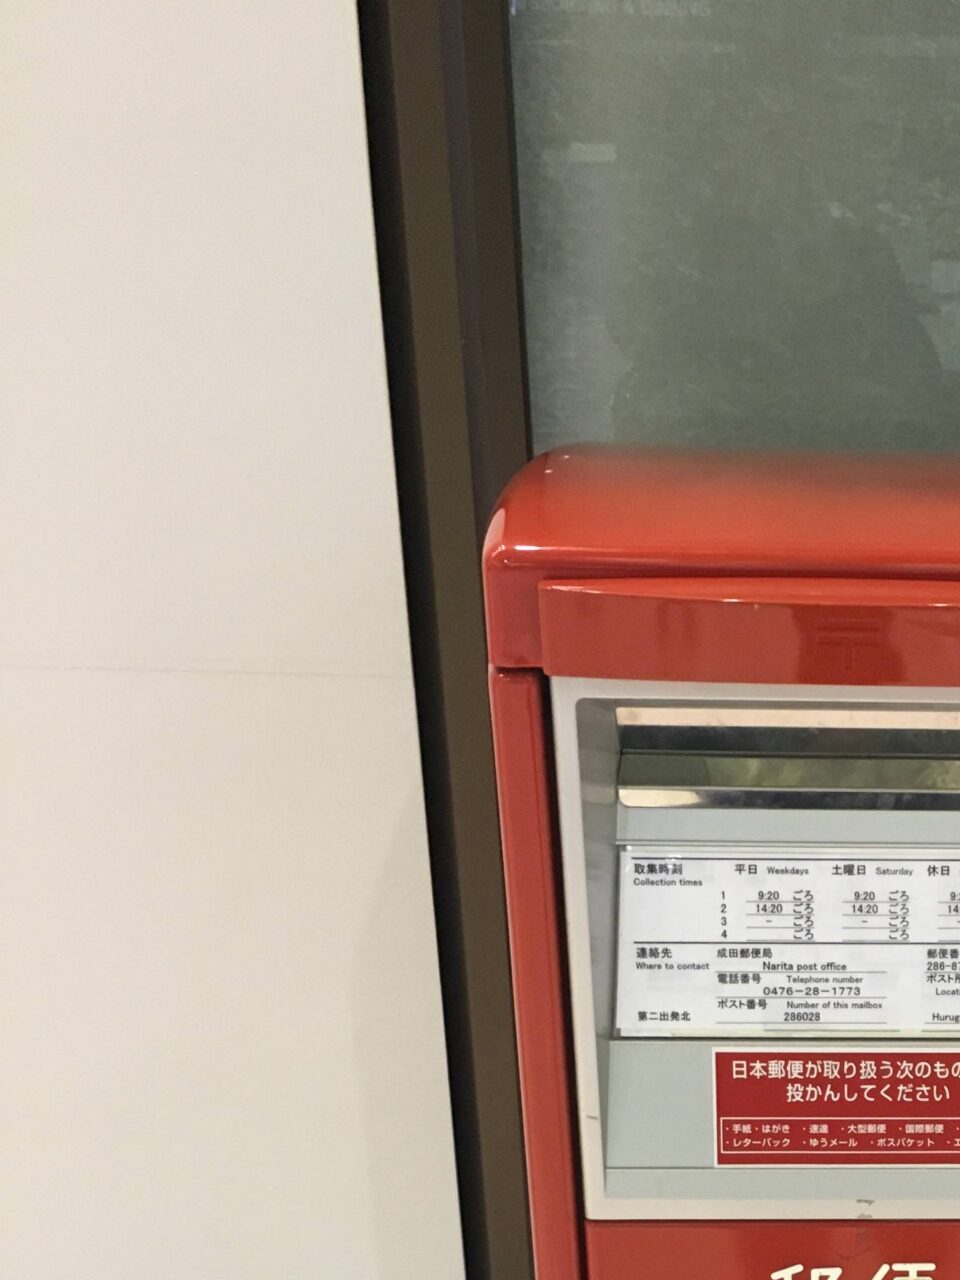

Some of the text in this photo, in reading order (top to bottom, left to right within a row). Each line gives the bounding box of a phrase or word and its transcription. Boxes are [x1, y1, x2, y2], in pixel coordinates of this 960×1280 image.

[634, 864, 683, 875] 取集時刻
[734, 864, 809, 876] 平日 Weekdays
[832, 865, 913, 876] 土曜日 Saturday
[927, 865, 950, 876] 休日
[634, 878, 703, 886] Collection times
[721, 891, 726, 899] 1
[758, 891, 780, 900] 9:20
[793, 891, 814, 901] ごろ
[854, 891, 876, 900] 9:20
[889, 891, 910, 901] ごろ
[721, 904, 727, 913] 2
[756, 904, 783, 913] 14:20
[793, 903, 814, 914] ごろ
[852, 904, 879, 913] 14:20
[889, 903, 910, 914] ごろ
[721, 917, 727, 926] 3
[793, 916, 814, 927] ごろ
[889, 916, 910, 927] ごろ
[721, 930, 727, 938] 4
[793, 929, 814, 940] ごろ
[889, 929, 910, 940] ごろ
[636, 948, 672, 959] 連絡先
[717, 948, 772, 959] 成田郵便局
[636, 962, 709, 970] Where to contact
[763, 962, 847, 972] Narita post office
[717, 973, 761, 984] 電話番号
[787, 975, 830, 985] Telephone
[763, 987, 861, 996] 0476-28-1773
[718, 999, 882, 1010] ポスト番号 Number of this mailbox
[638, 1011, 691, 1021] 第二出発北
[784, 1012, 820, 1021] 286028
[786, 1084, 950, 1103] 投かんしてください
